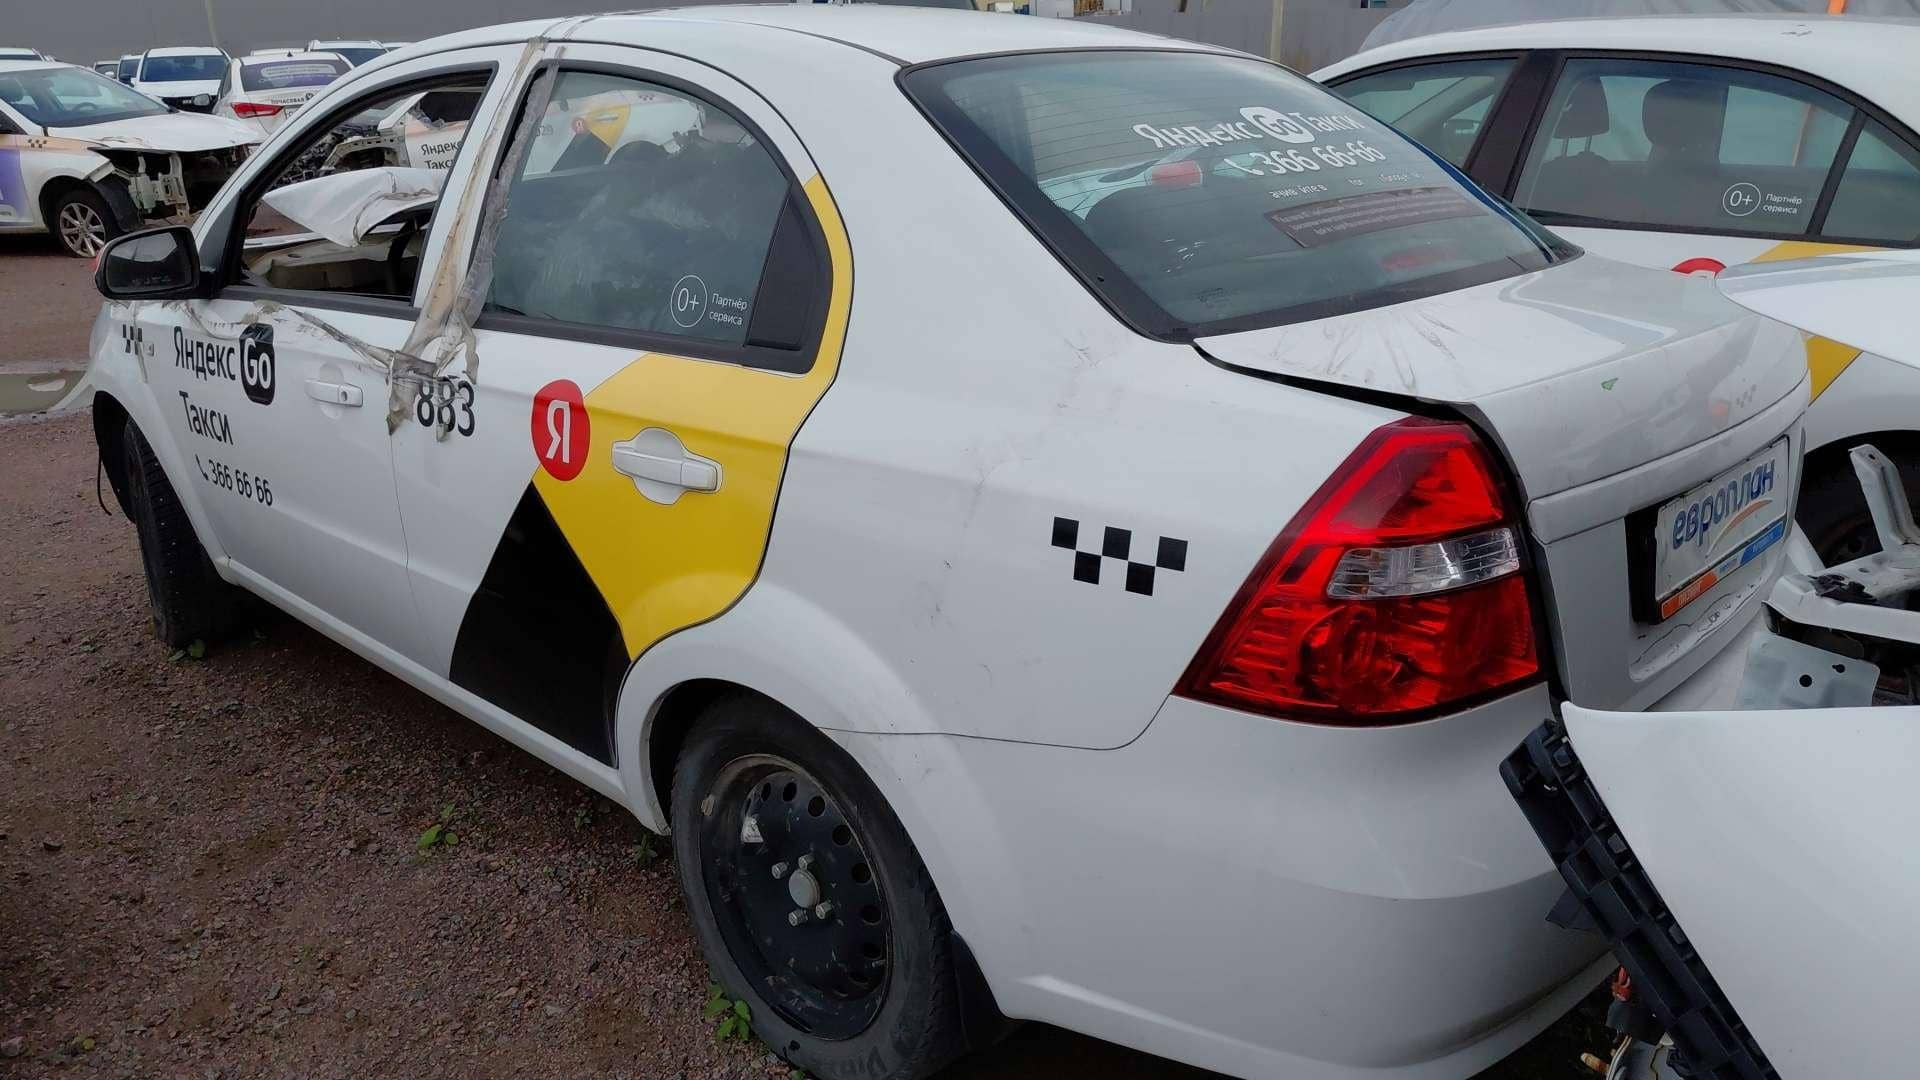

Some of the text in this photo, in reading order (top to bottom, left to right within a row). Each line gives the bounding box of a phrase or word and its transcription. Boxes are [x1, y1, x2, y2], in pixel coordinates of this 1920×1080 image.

[1132, 121, 1263, 148] Яндекс
[1288, 112, 1365, 133] Такси
[1249, 140, 1386, 174] 366 66-66
[1730, 190, 1753, 207] 0+
[1763, 204, 1798, 214] сервиса
[678, 287, 699, 311] 0+
[712, 293, 748, 311] Партнёр
[709, 311, 744, 326] сервиса
[174, 325, 272, 390] Яндекс Go
[179, 390, 234, 446] Такси
[417, 377, 475, 437] 883
[546, 399, 571, 464] Я
[209, 459, 273, 506] 366 66 66
[1672, 459, 1775, 550] европлан
